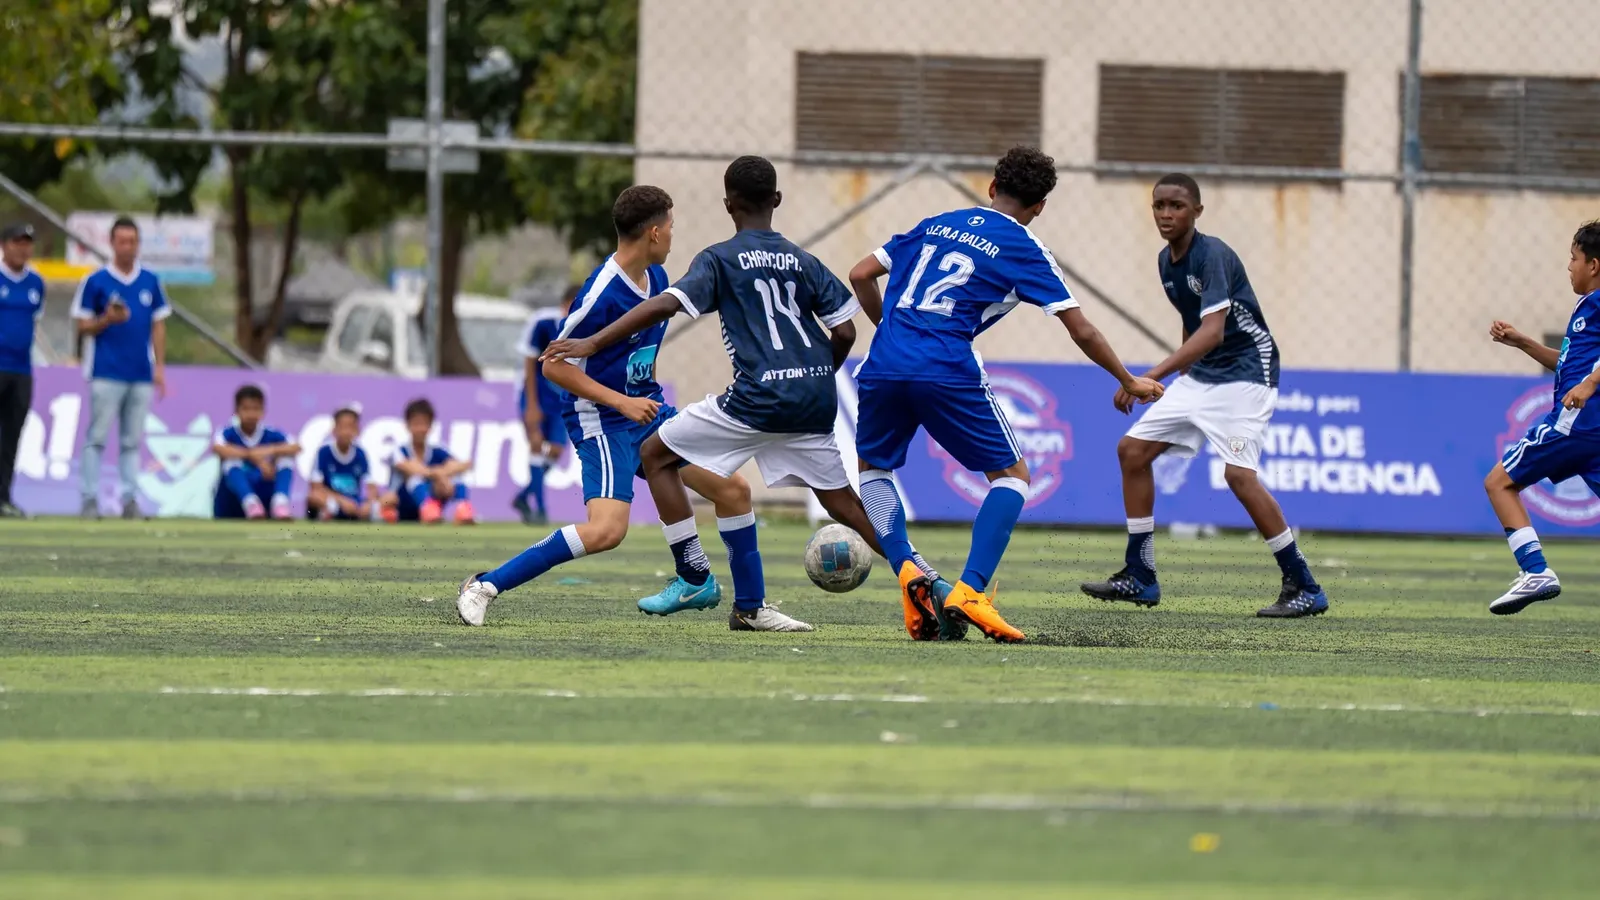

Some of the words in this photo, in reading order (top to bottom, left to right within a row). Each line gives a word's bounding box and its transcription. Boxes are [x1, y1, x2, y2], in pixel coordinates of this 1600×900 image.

[958, 233, 1000, 258] BALZAR
[896, 243, 975, 317] 12
[754, 278, 811, 350] 14
[761, 368, 803, 381] AYTON
[1319, 425, 1366, 458] DE
[1208, 458, 1442, 495] NEFICENCIA
